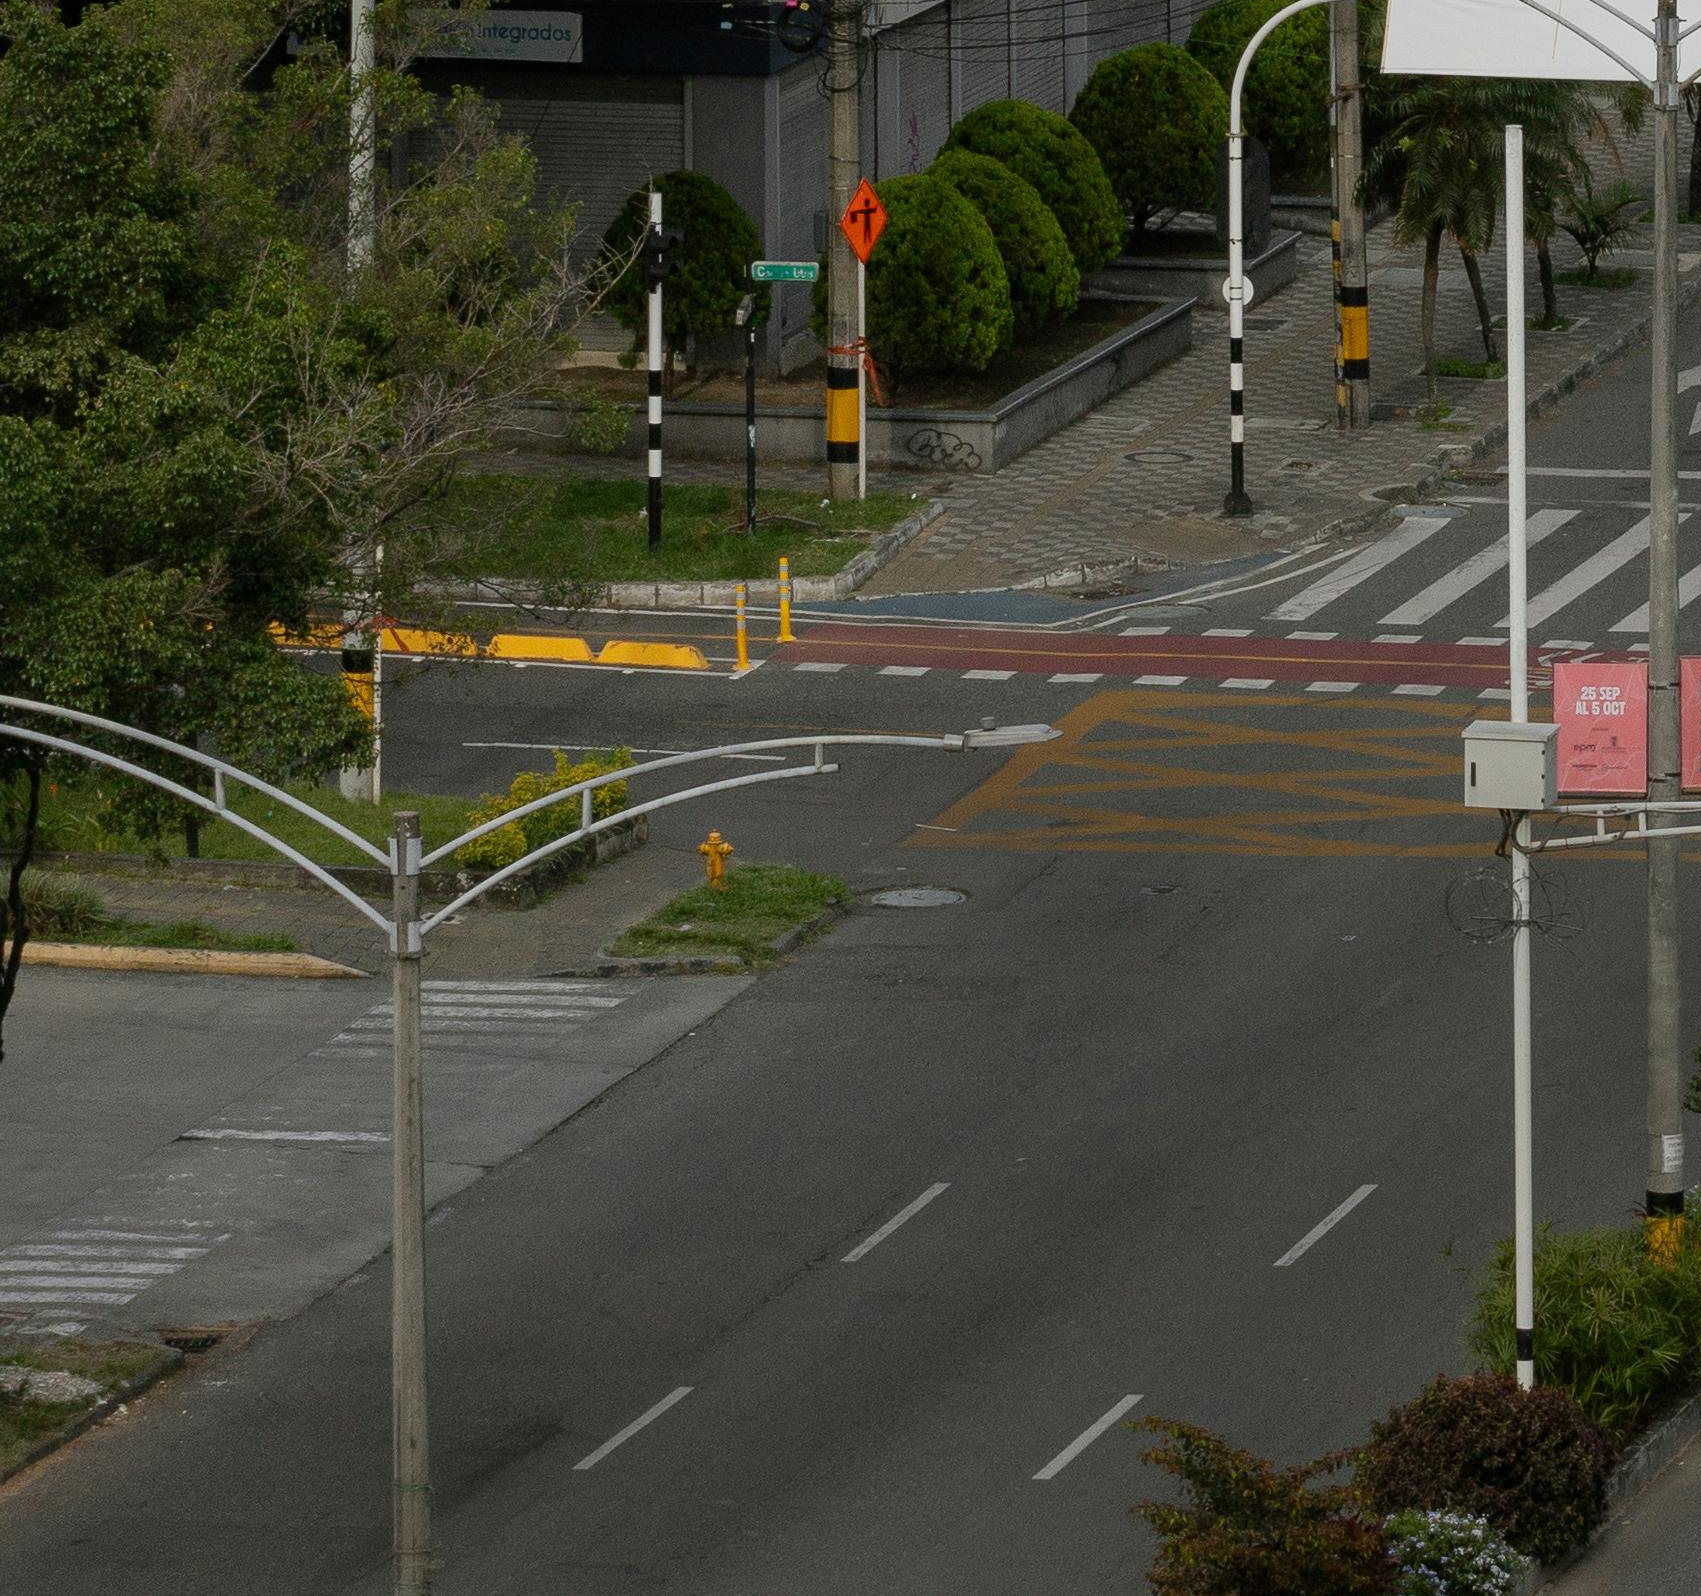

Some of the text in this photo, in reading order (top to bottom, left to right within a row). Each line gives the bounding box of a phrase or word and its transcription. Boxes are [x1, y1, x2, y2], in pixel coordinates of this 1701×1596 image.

[1600, 686, 1620, 700] SEP
[1575, 701, 1626, 715] AL 5 OCT
